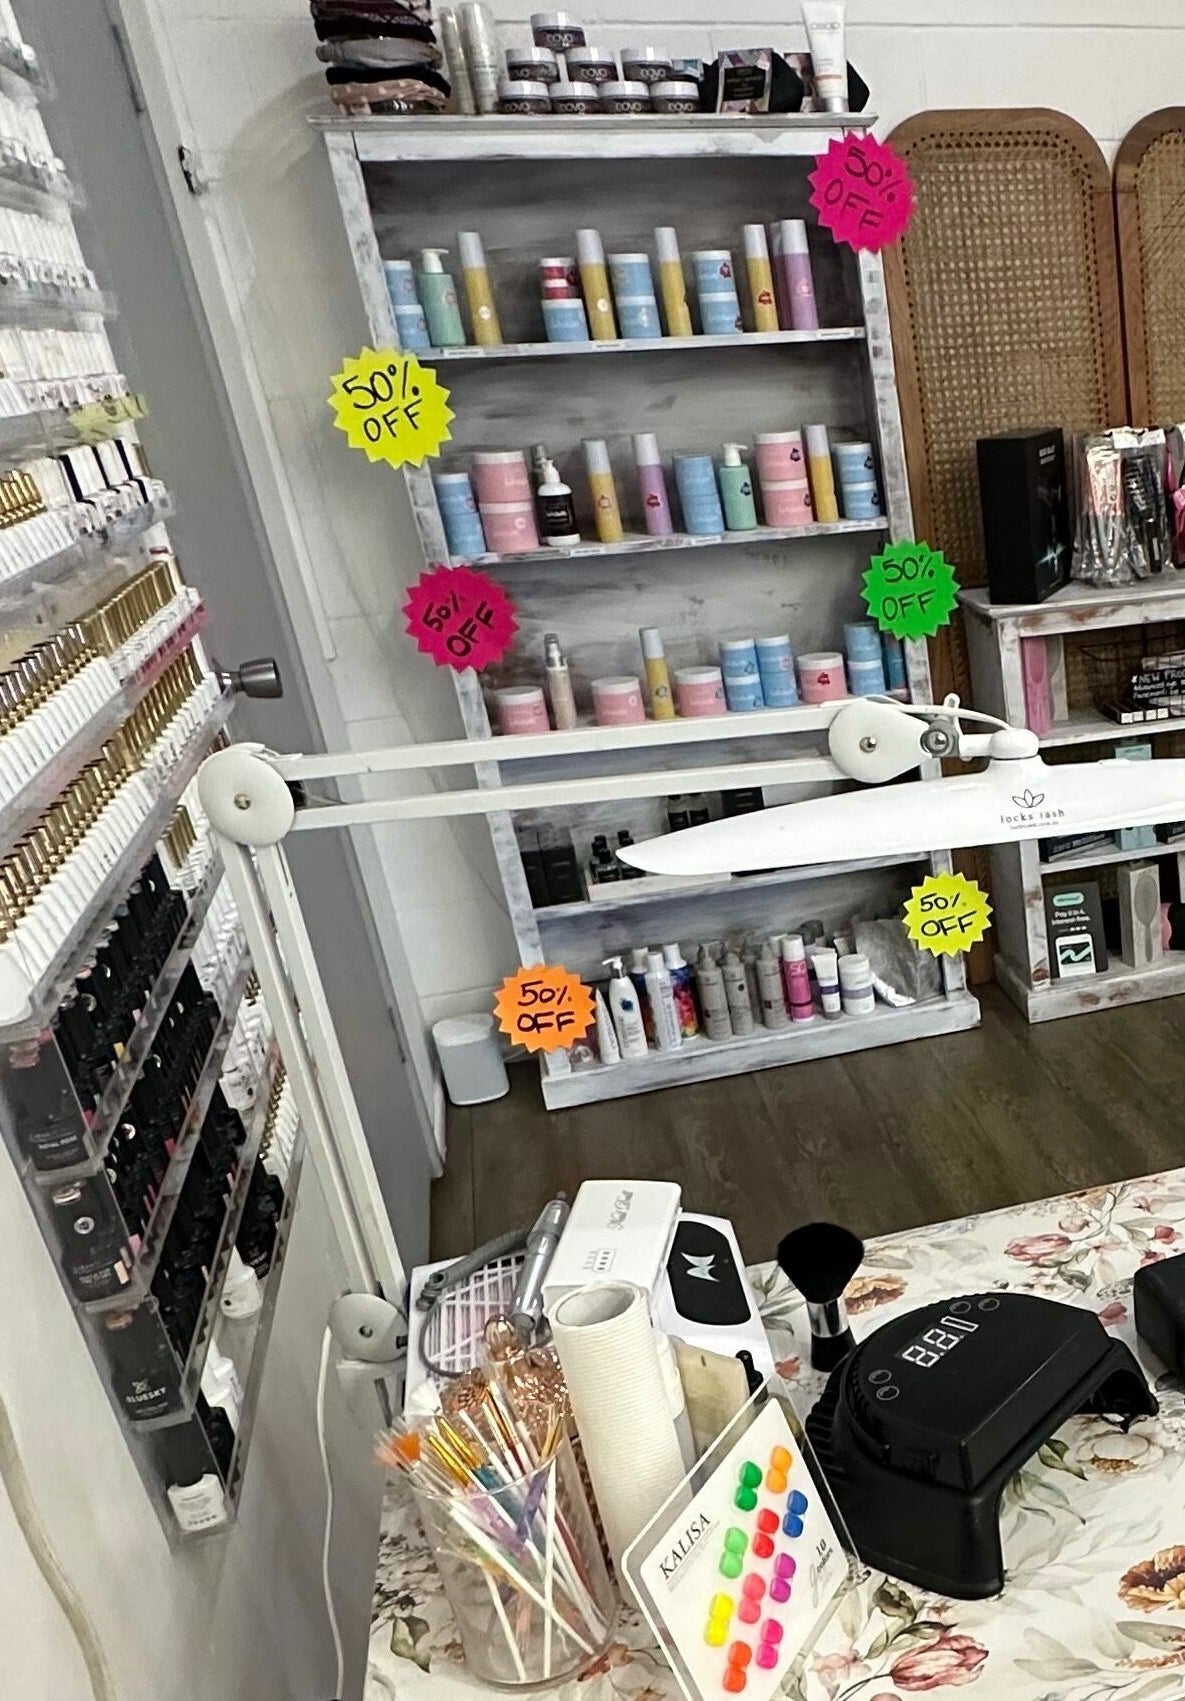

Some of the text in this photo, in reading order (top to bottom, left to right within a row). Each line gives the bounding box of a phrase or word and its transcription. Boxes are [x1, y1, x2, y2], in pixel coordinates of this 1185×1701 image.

[844, 146, 903, 203] 50%
[824, 178, 884, 230] OFF
[342, 361, 420, 409] 50%
[363, 398, 422, 442] OFF
[882, 554, 935, 583] 50%
[422, 589, 467, 633] 50%
[882, 588, 937, 622] OFF
[446, 600, 496, 658] OFF
[1000, 809, 1065, 823] locks lash
[920, 892, 967, 912] 50%
[921, 910, 977, 937] OFF
[518, 980, 572, 1006] 50%
[517, 1011, 574, 1034] OFF
[659, 1513, 712, 1581] KALISA
[815, 1538, 828, 1555] 10
